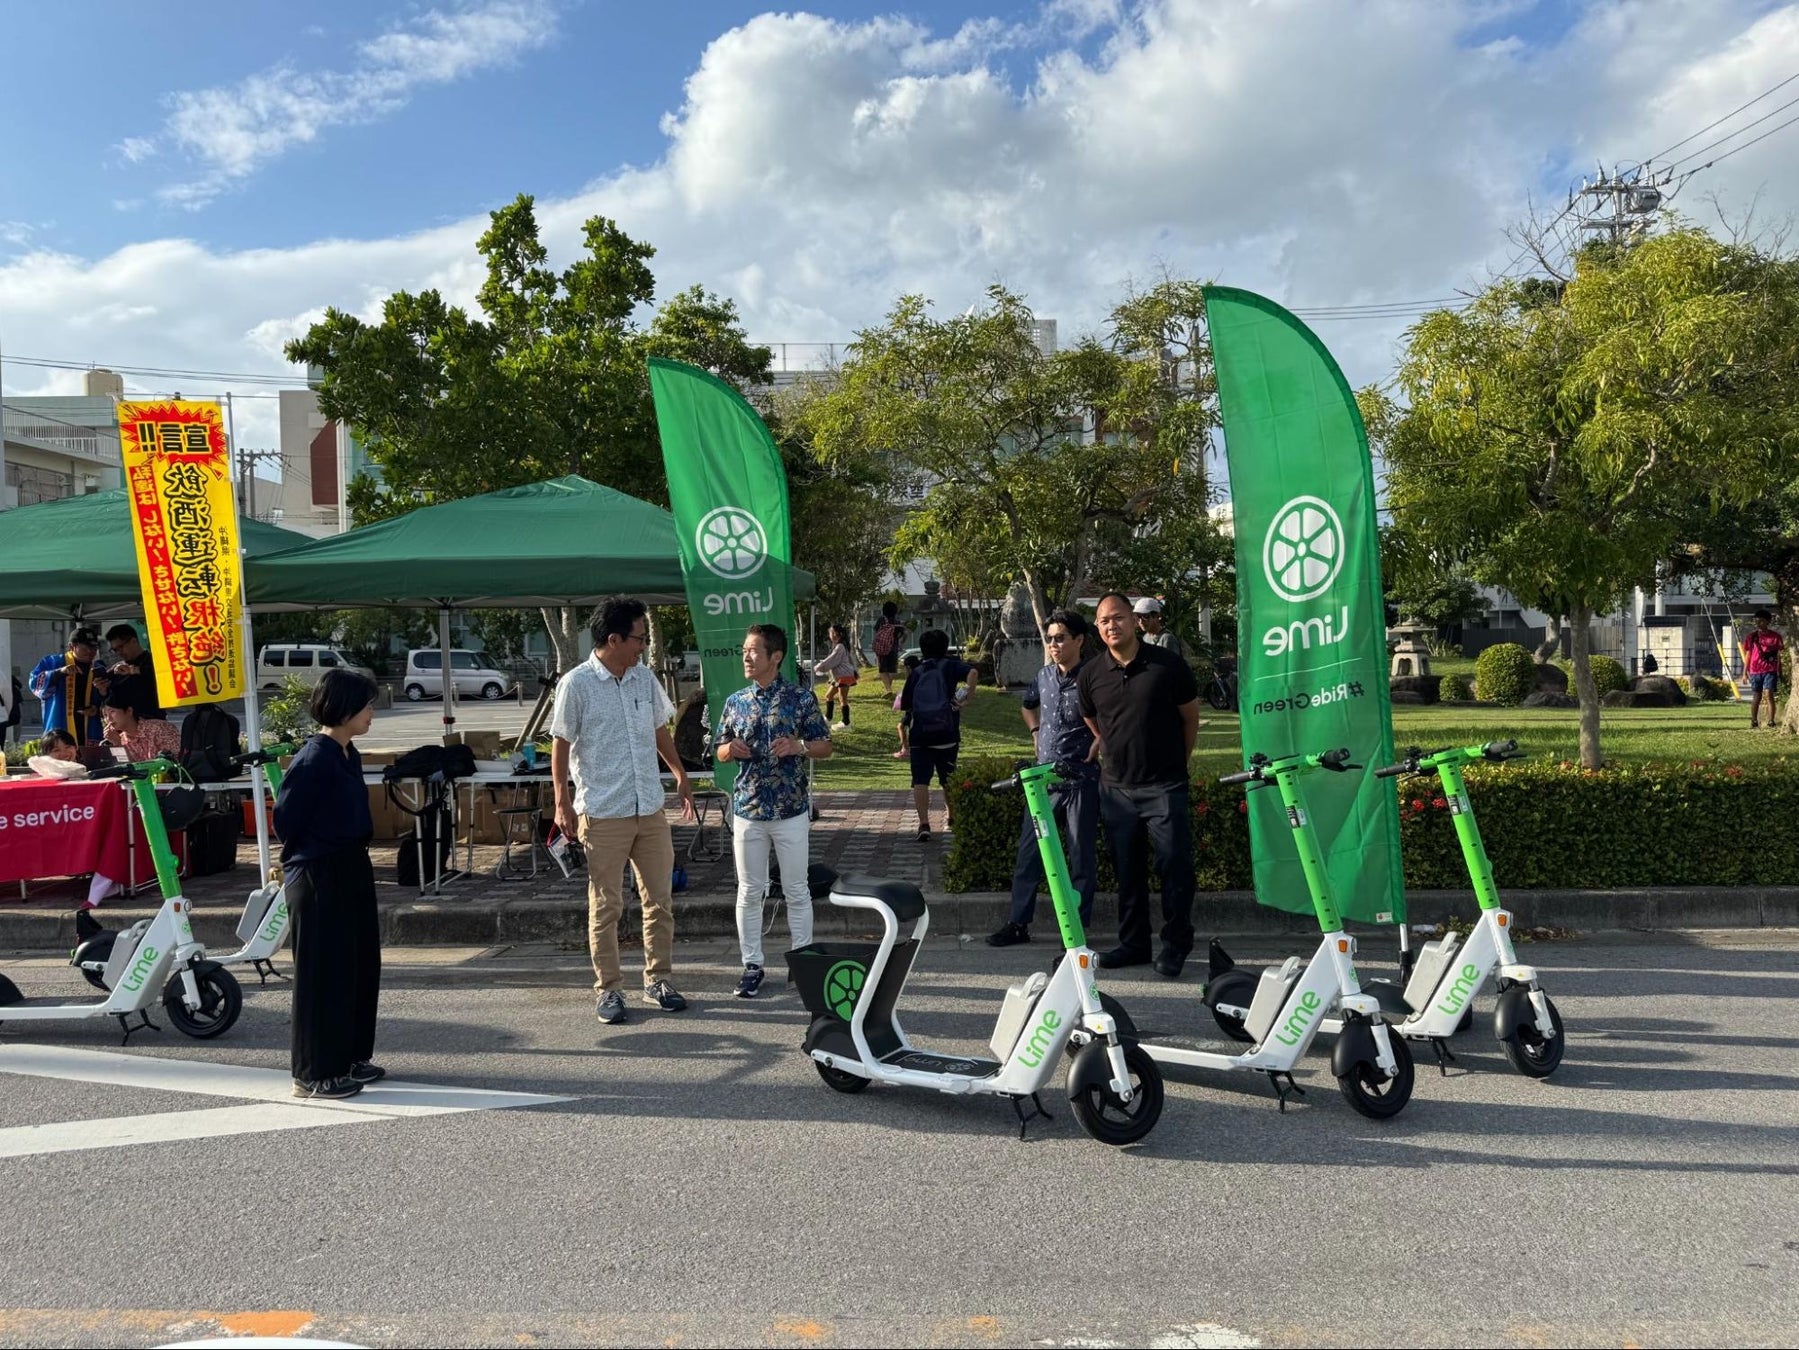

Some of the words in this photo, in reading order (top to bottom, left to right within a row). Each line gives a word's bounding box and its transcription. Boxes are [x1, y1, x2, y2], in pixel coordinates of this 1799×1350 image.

[13, 804, 95, 828] service
[259, 902, 288, 942] Lime
[122, 945, 159, 993] Lime
[1437, 962, 1480, 1016] Lime
[1017, 1008, 1062, 1069] Lime
[1276, 990, 1321, 1047] Lime
